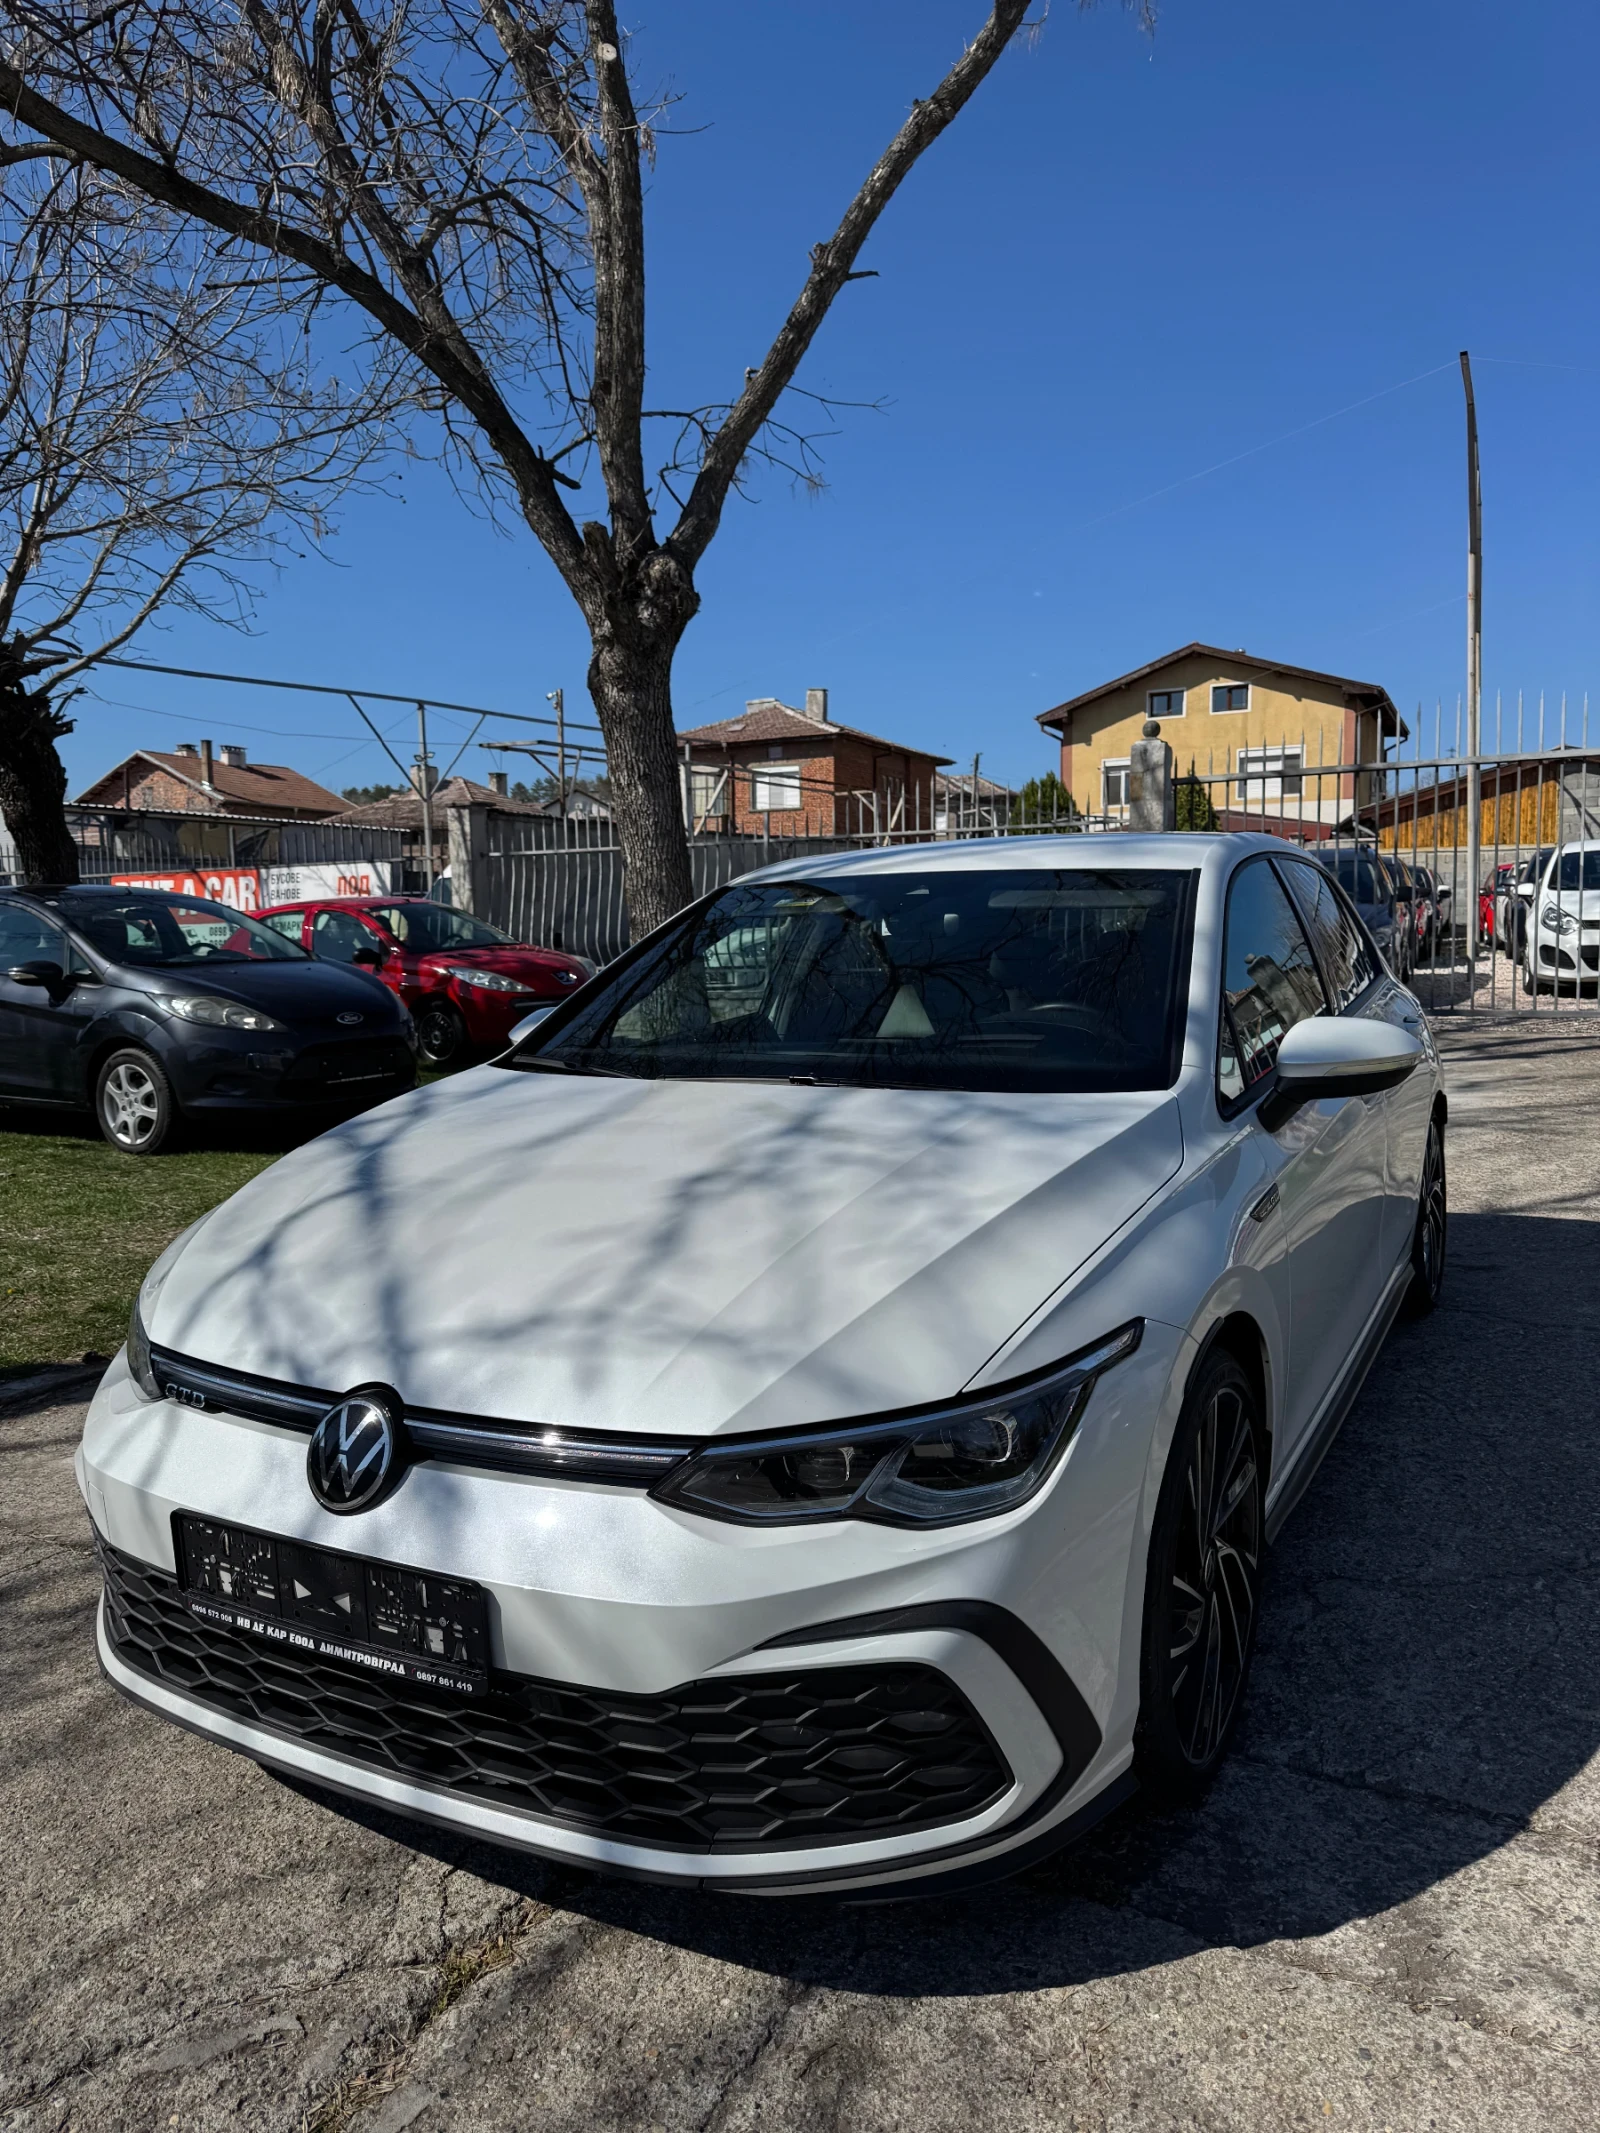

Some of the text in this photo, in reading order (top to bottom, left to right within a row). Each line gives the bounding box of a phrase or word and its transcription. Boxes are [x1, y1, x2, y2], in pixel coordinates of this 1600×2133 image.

[270, 872, 302, 885] БУСОВЕ
[337, 875, 371, 897] ПОД
[204, 876, 258, 912] CAR
[270, 888, 302, 900] ВАНОВЕ
[165, 1383, 206, 1408] GTD
[252, 1621, 265, 1634] ДЕ
[266, 1625, 287, 1640] КАР
[289, 1633, 315, 1650] ЕООД
[319, 1642, 406, 1675] ДИМИТРОВГРАД
[416, 1671, 437, 1683] 0897
[456, 1681, 473, 1692] 419
